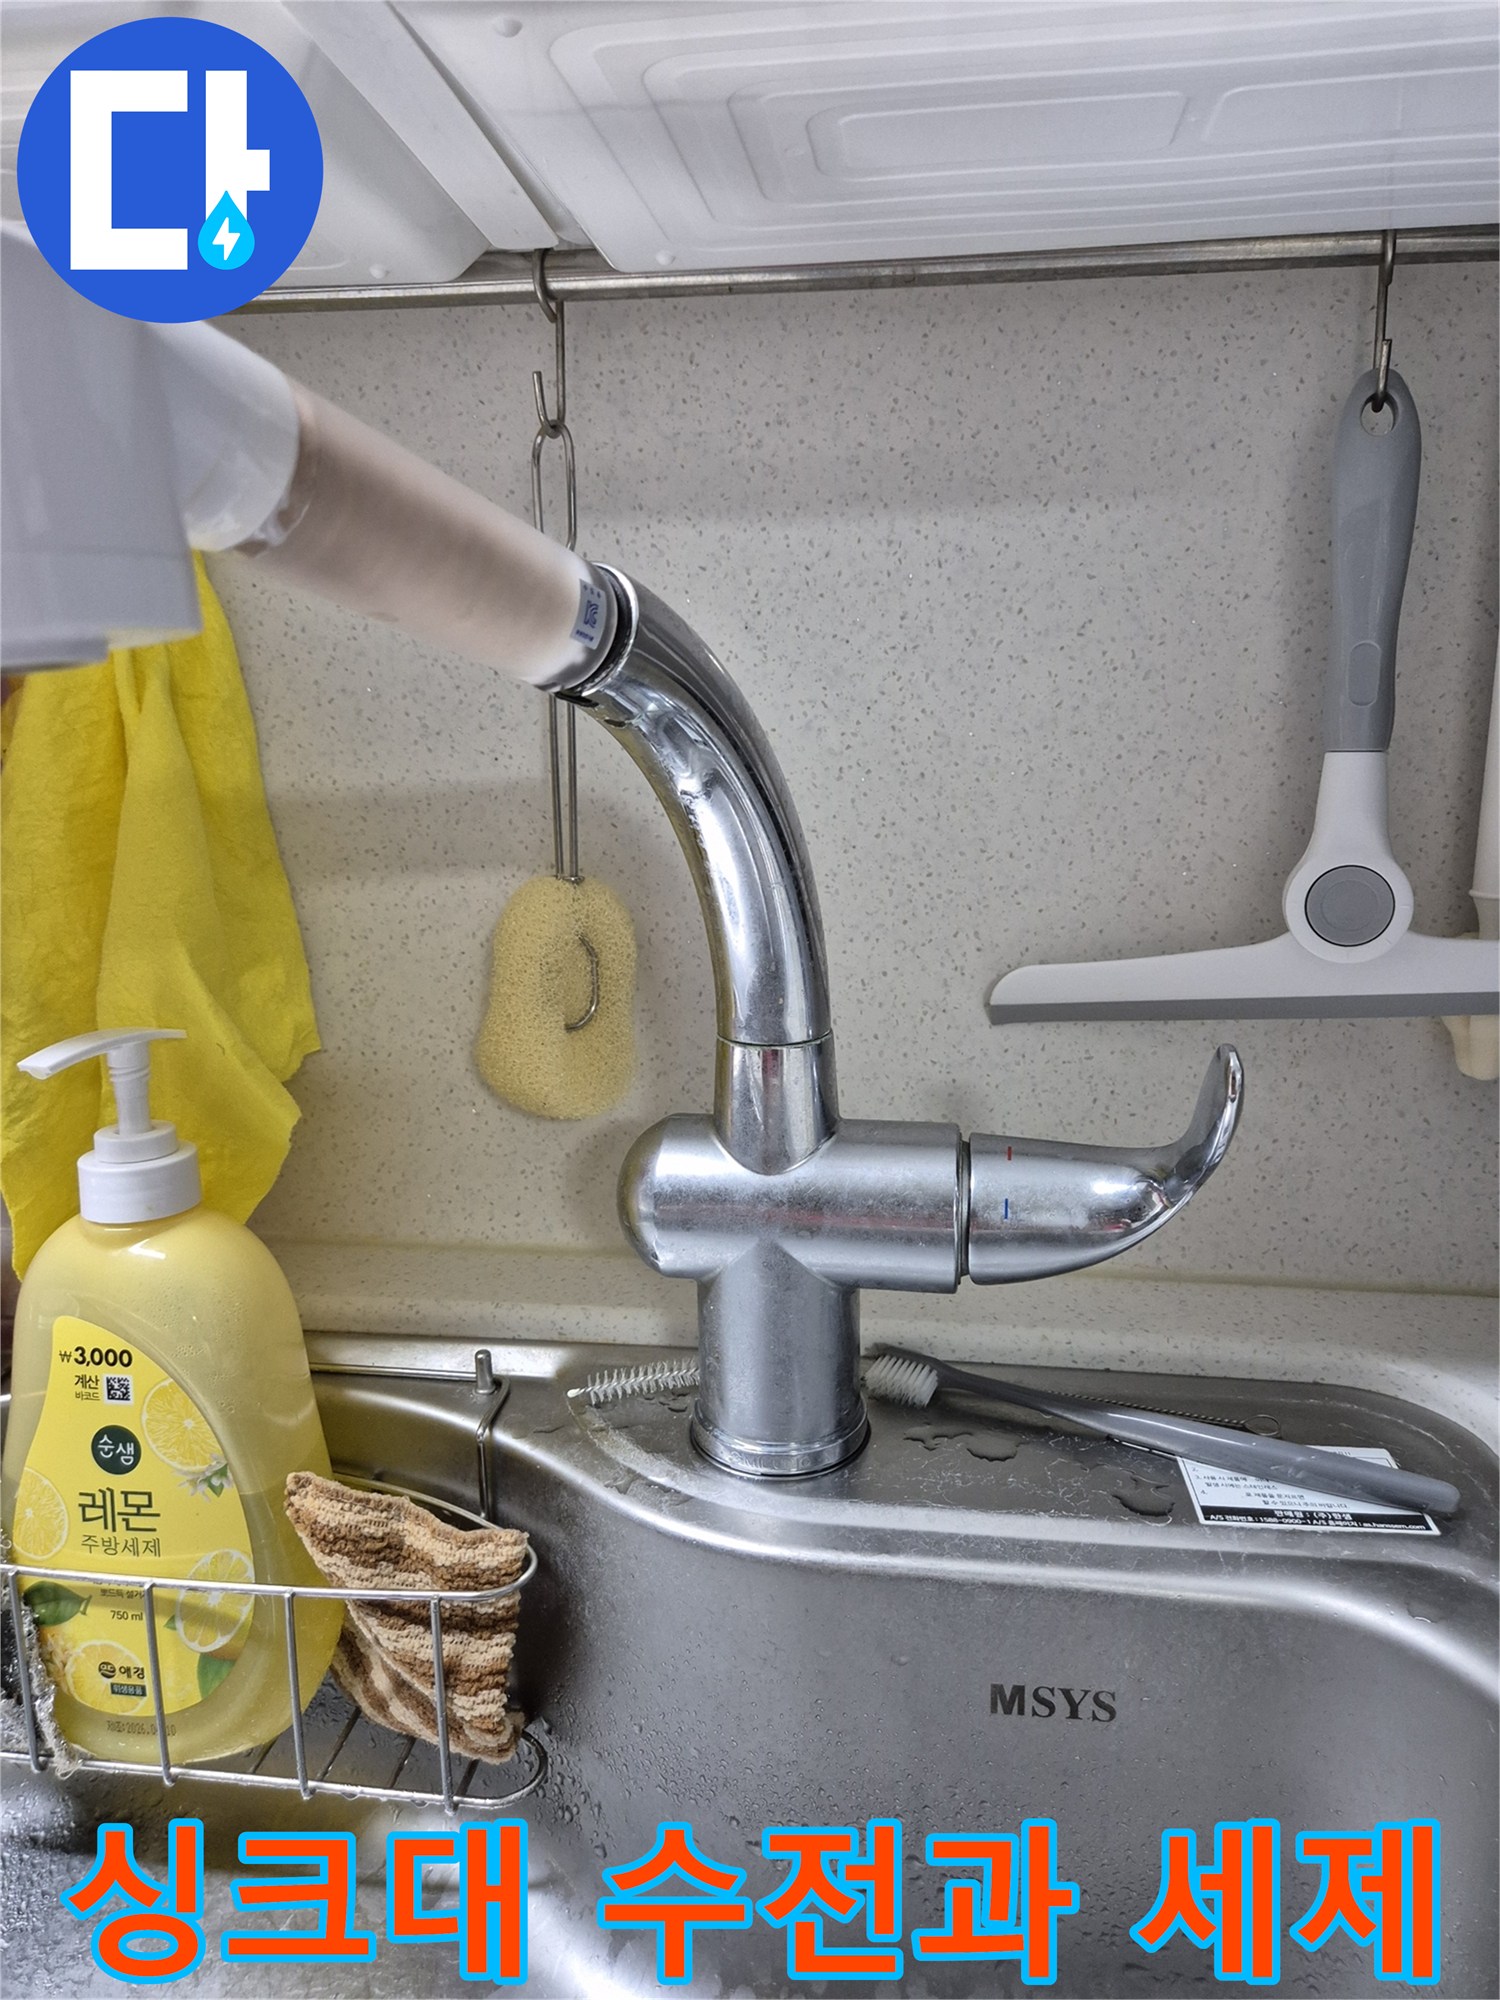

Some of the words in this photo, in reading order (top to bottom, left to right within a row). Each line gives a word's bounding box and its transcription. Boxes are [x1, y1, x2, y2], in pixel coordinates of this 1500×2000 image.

[59, 1346, 133, 1368] ₩3,000
[75, 1374, 100, 1389] 계산
[75, 1391, 101, 1401] 바코드
[97, 1434, 135, 1466] 순샘
[78, 1487, 161, 1533] 레몬
[81, 1534, 161, 1557] 주방세제
[110, 1610, 129, 1621] 750
[131, 1612, 144, 1621] ml
[118, 1666, 145, 1680] 애경
[990, 1683, 1117, 1723] MSYS
